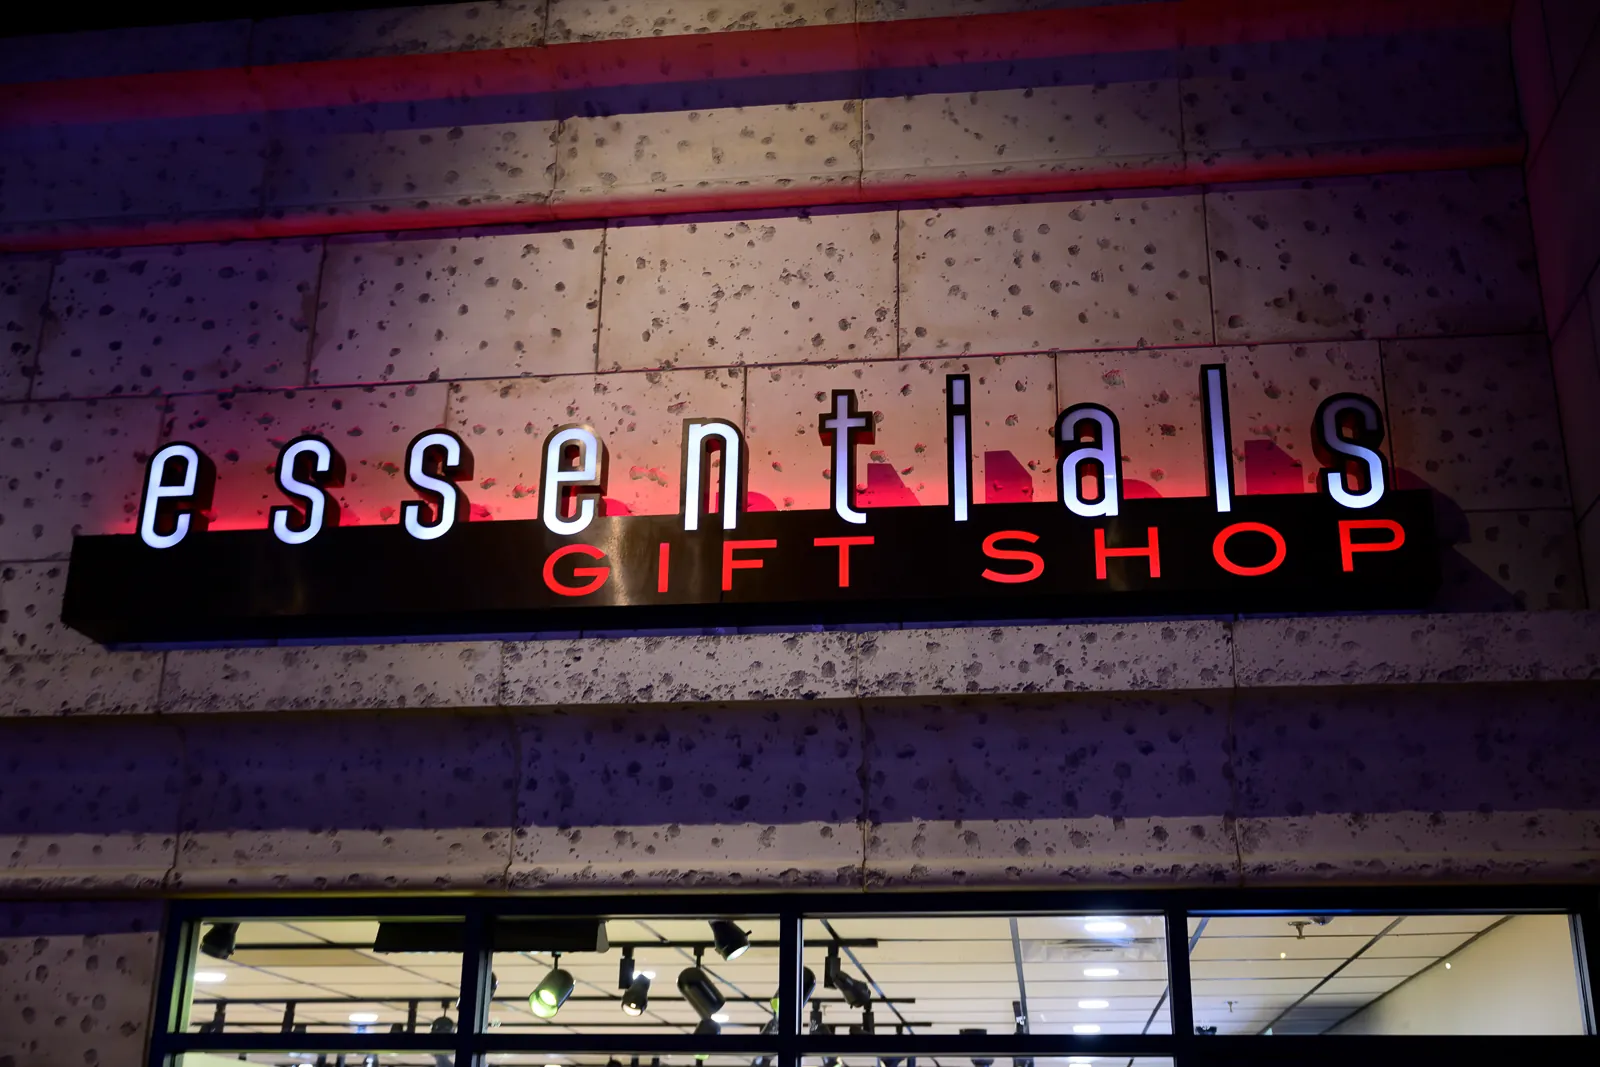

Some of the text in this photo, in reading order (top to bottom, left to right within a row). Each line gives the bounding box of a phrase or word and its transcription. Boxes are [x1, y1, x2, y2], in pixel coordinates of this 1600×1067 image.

[139, 364, 1388, 549] essentials
[542, 518, 1407, 598] GIFT SHOP
